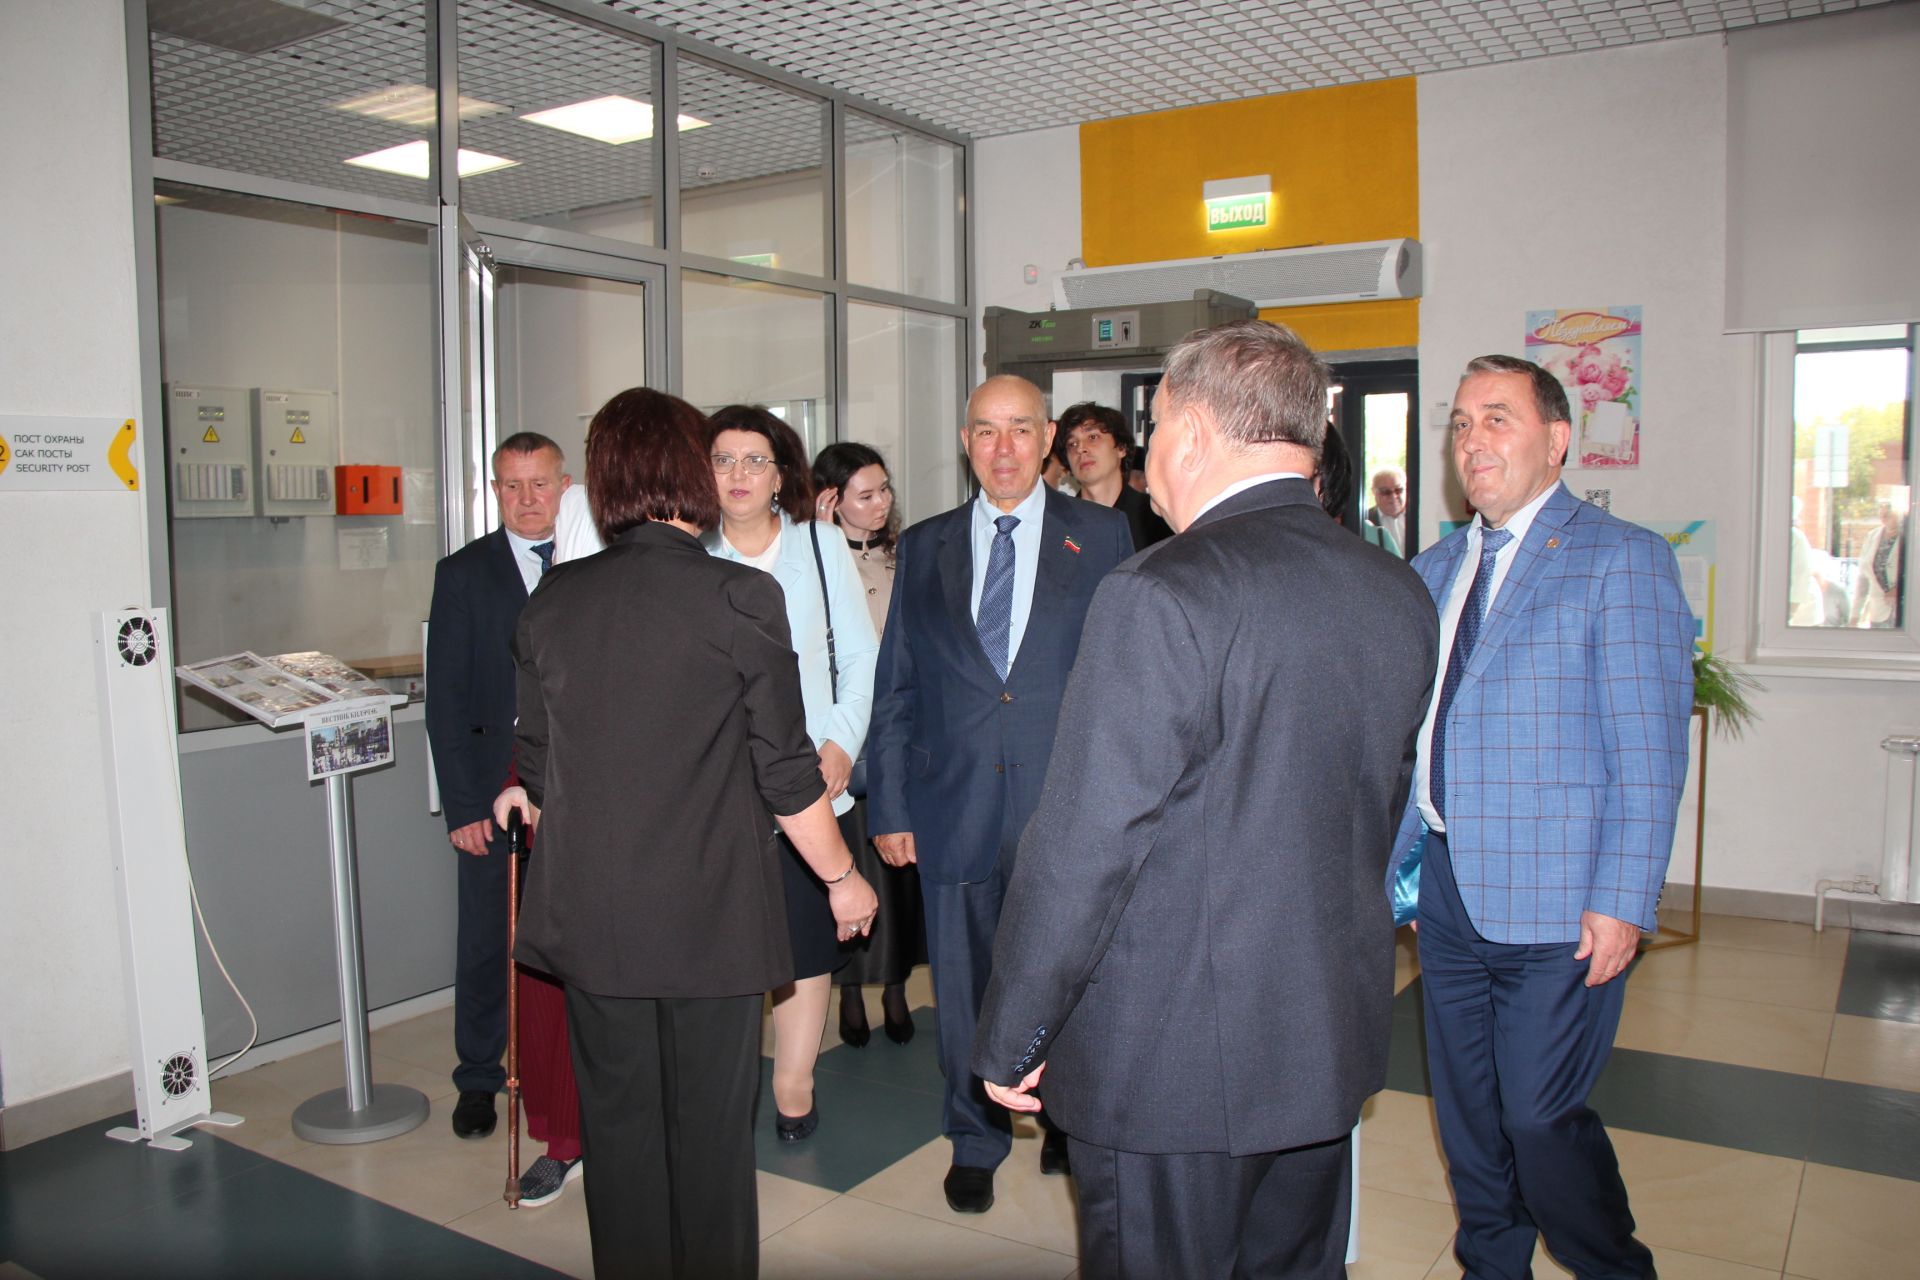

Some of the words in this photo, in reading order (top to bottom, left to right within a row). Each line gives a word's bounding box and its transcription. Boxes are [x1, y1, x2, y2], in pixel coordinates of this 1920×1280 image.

[1210, 202, 1265, 225] ВЫХОД
[14, 434, 41, 443] ПОСТ
[44, 434, 84, 444] ОХРАНЫ
[15, 449, 35, 458] САК
[37, 449, 73, 459] ПОСТЫ
[16, 463, 64, 473] SECURITY
[66, 464, 90, 473] POST
